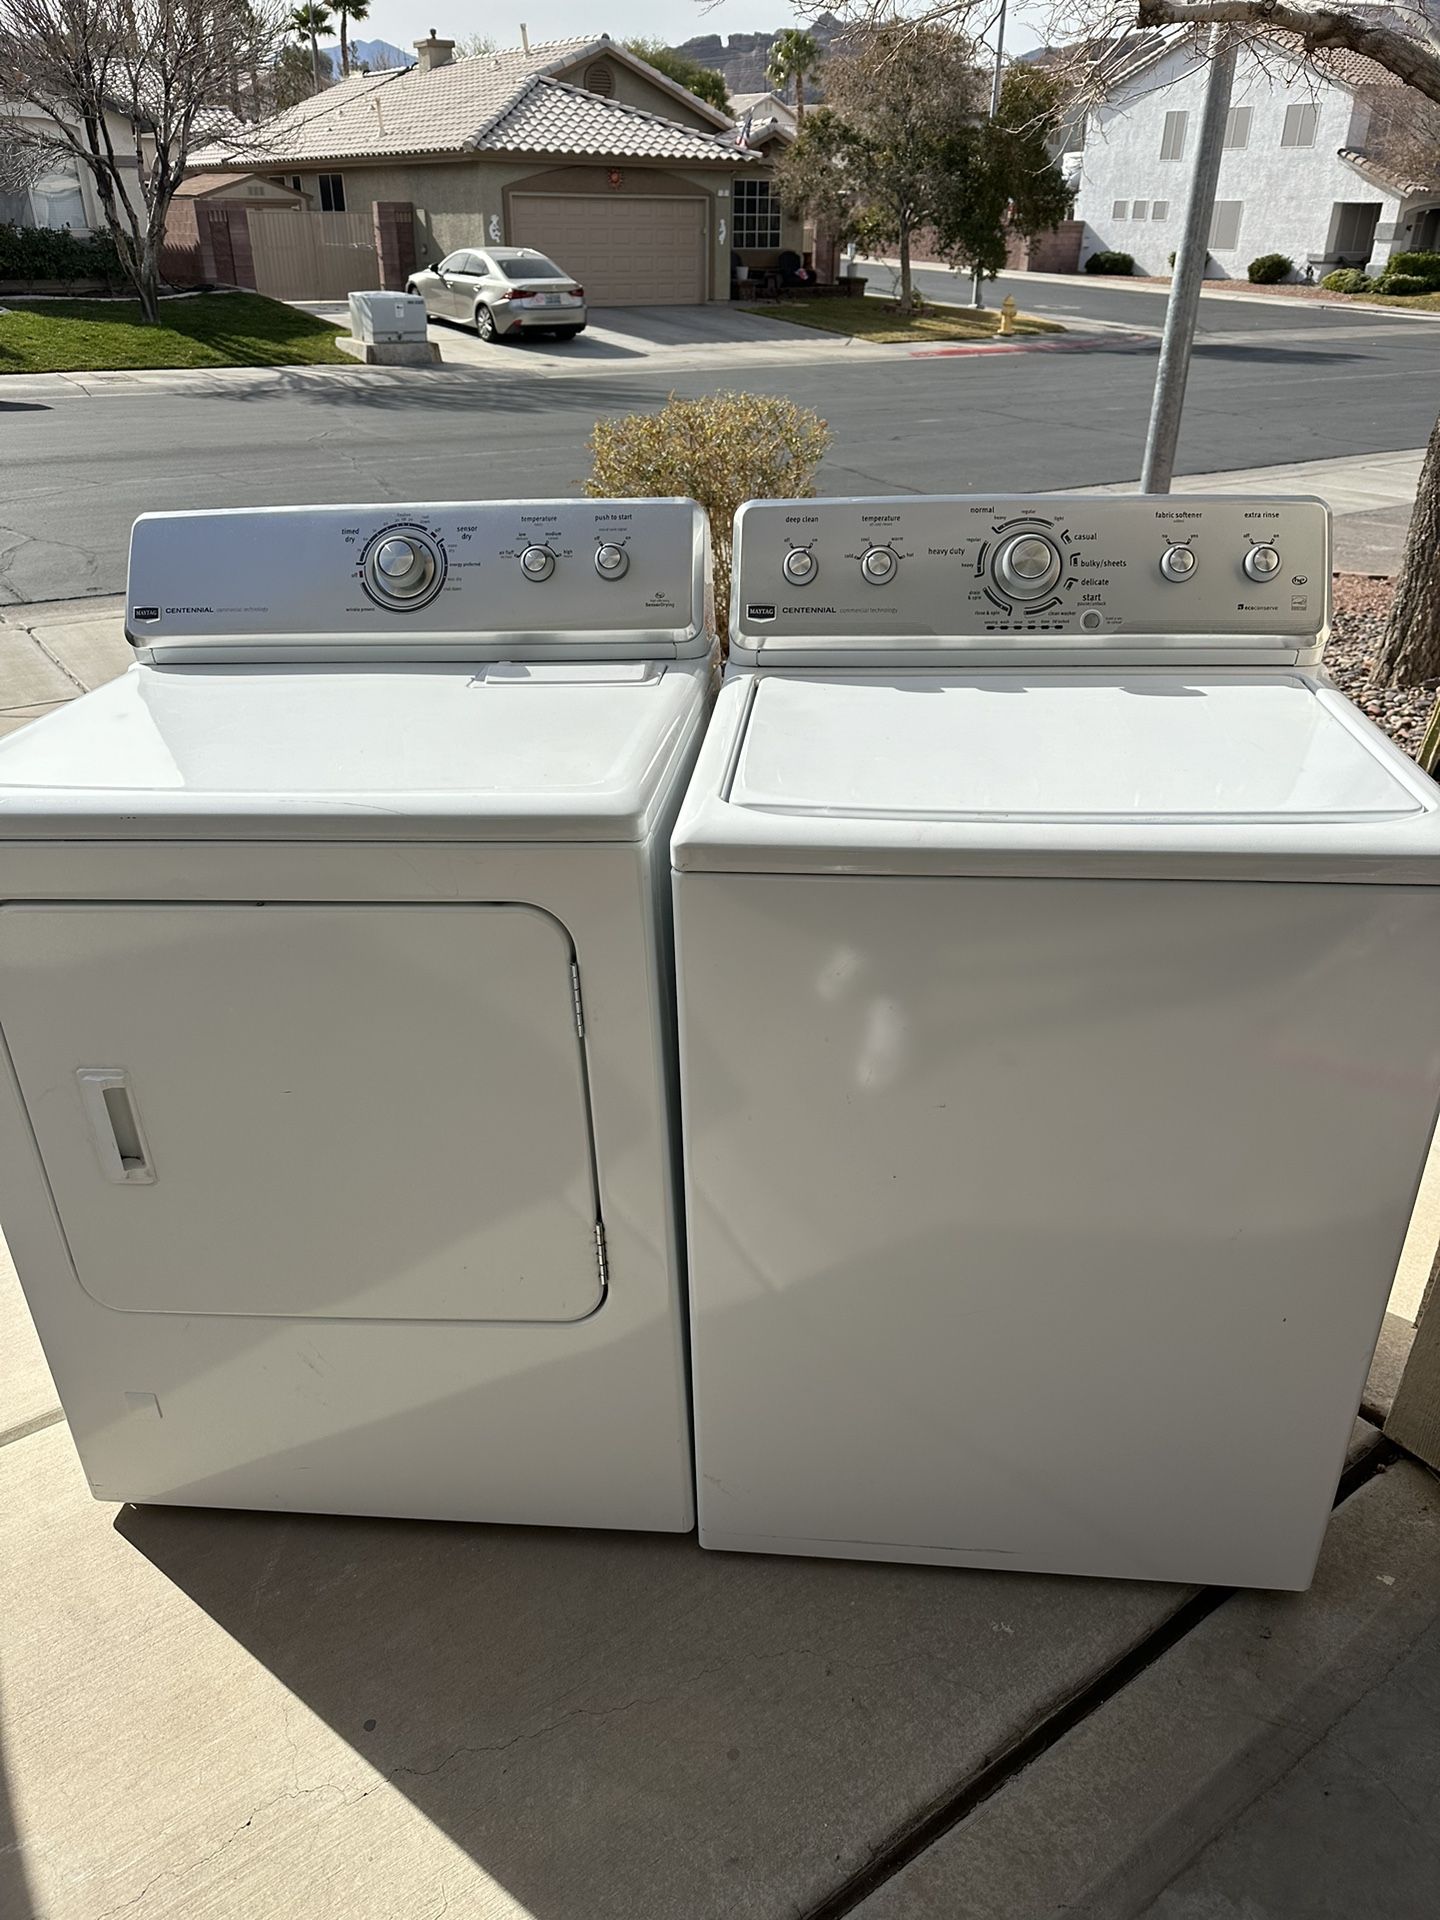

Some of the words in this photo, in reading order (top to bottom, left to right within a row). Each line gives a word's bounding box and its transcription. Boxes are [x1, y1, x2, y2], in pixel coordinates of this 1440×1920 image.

[521, 515, 557, 523] temperature
[594, 514, 610, 522] push
[1155, 511, 1174, 519] fabric
[1175, 511, 1202, 519] softener
[785, 516, 800, 524] deep
[462, 533, 472, 541] dry
[928, 548, 948, 556] heavy
[949, 548, 965, 556] duty
[1080, 560, 1127, 568] bulky/sheets
[1081, 578, 1109, 586] delicate
